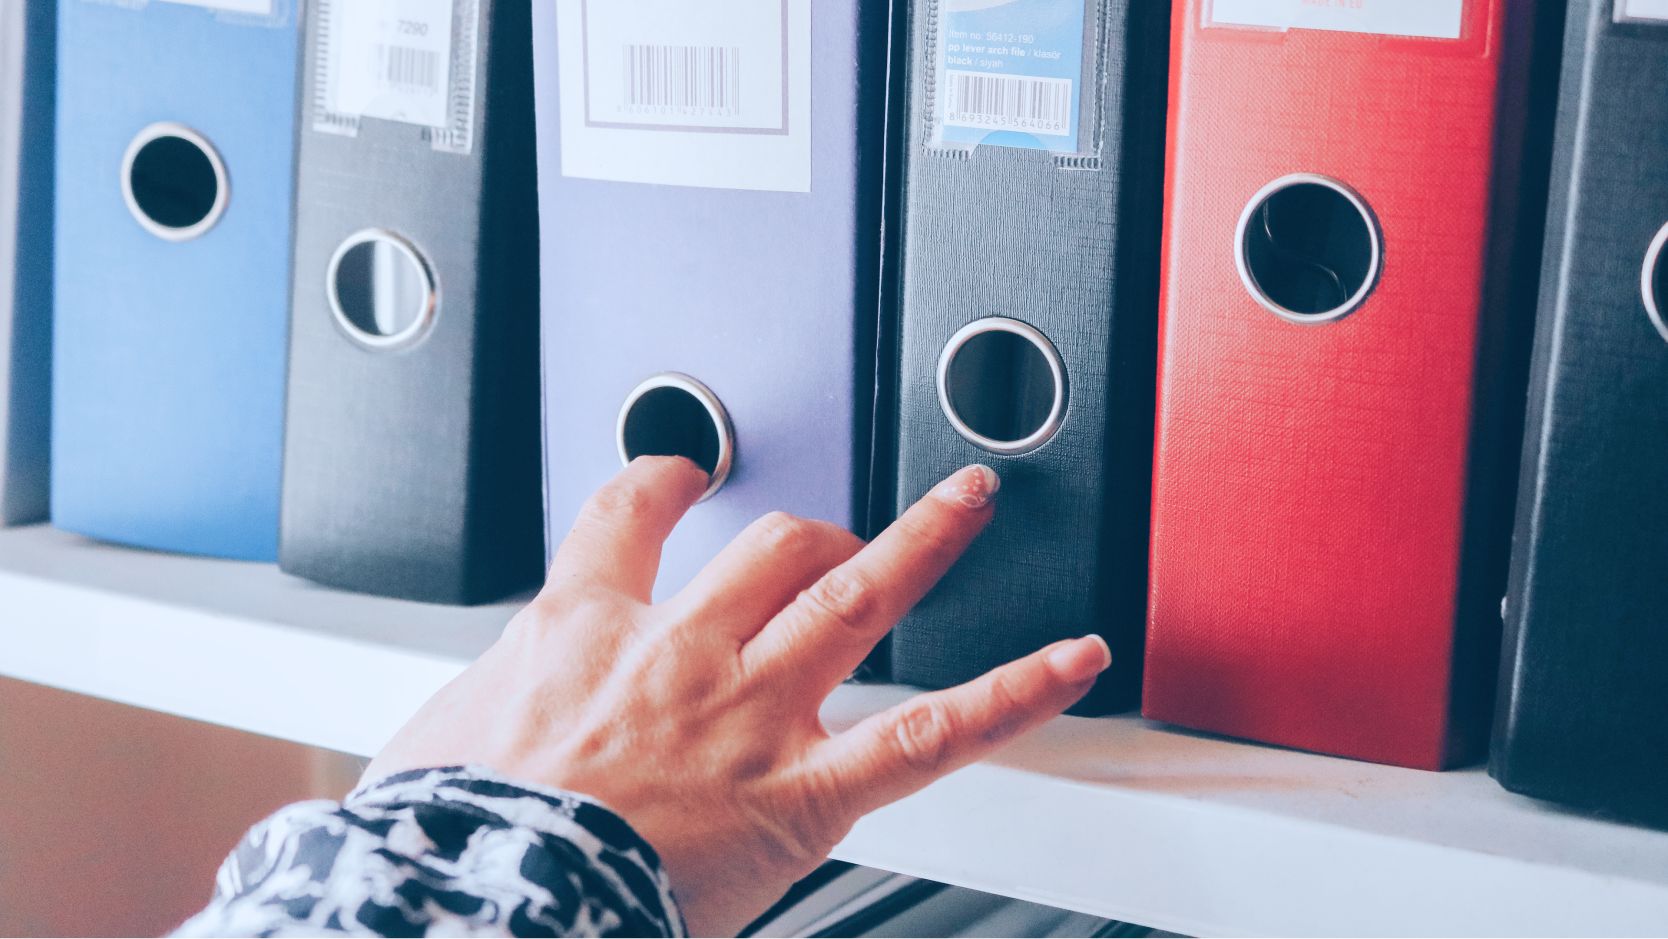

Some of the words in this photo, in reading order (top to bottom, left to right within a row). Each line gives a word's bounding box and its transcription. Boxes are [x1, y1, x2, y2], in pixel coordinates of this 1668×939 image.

[397, 19, 429, 37] 7290
[962, 43, 986, 54] lever
[987, 45, 1009, 55] arch
[1011, 46, 1026, 57] file
[948, 55, 972, 65] black
